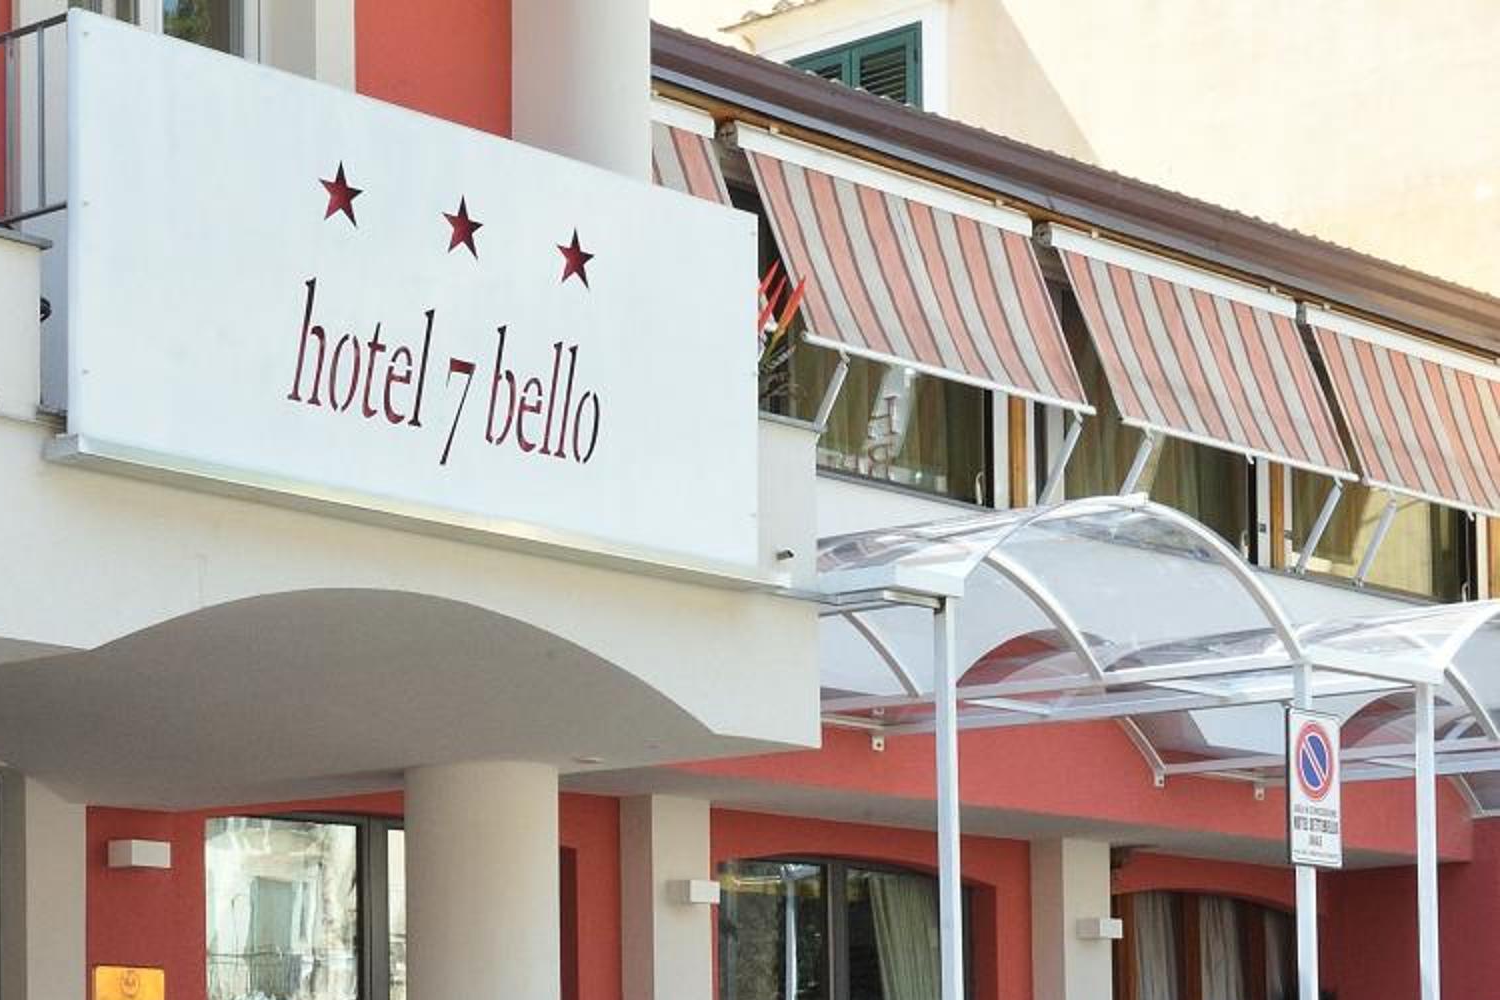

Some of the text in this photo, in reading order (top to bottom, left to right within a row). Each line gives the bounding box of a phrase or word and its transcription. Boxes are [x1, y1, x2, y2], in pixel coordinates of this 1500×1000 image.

[288, 277, 600, 465] hotel 7 bello
